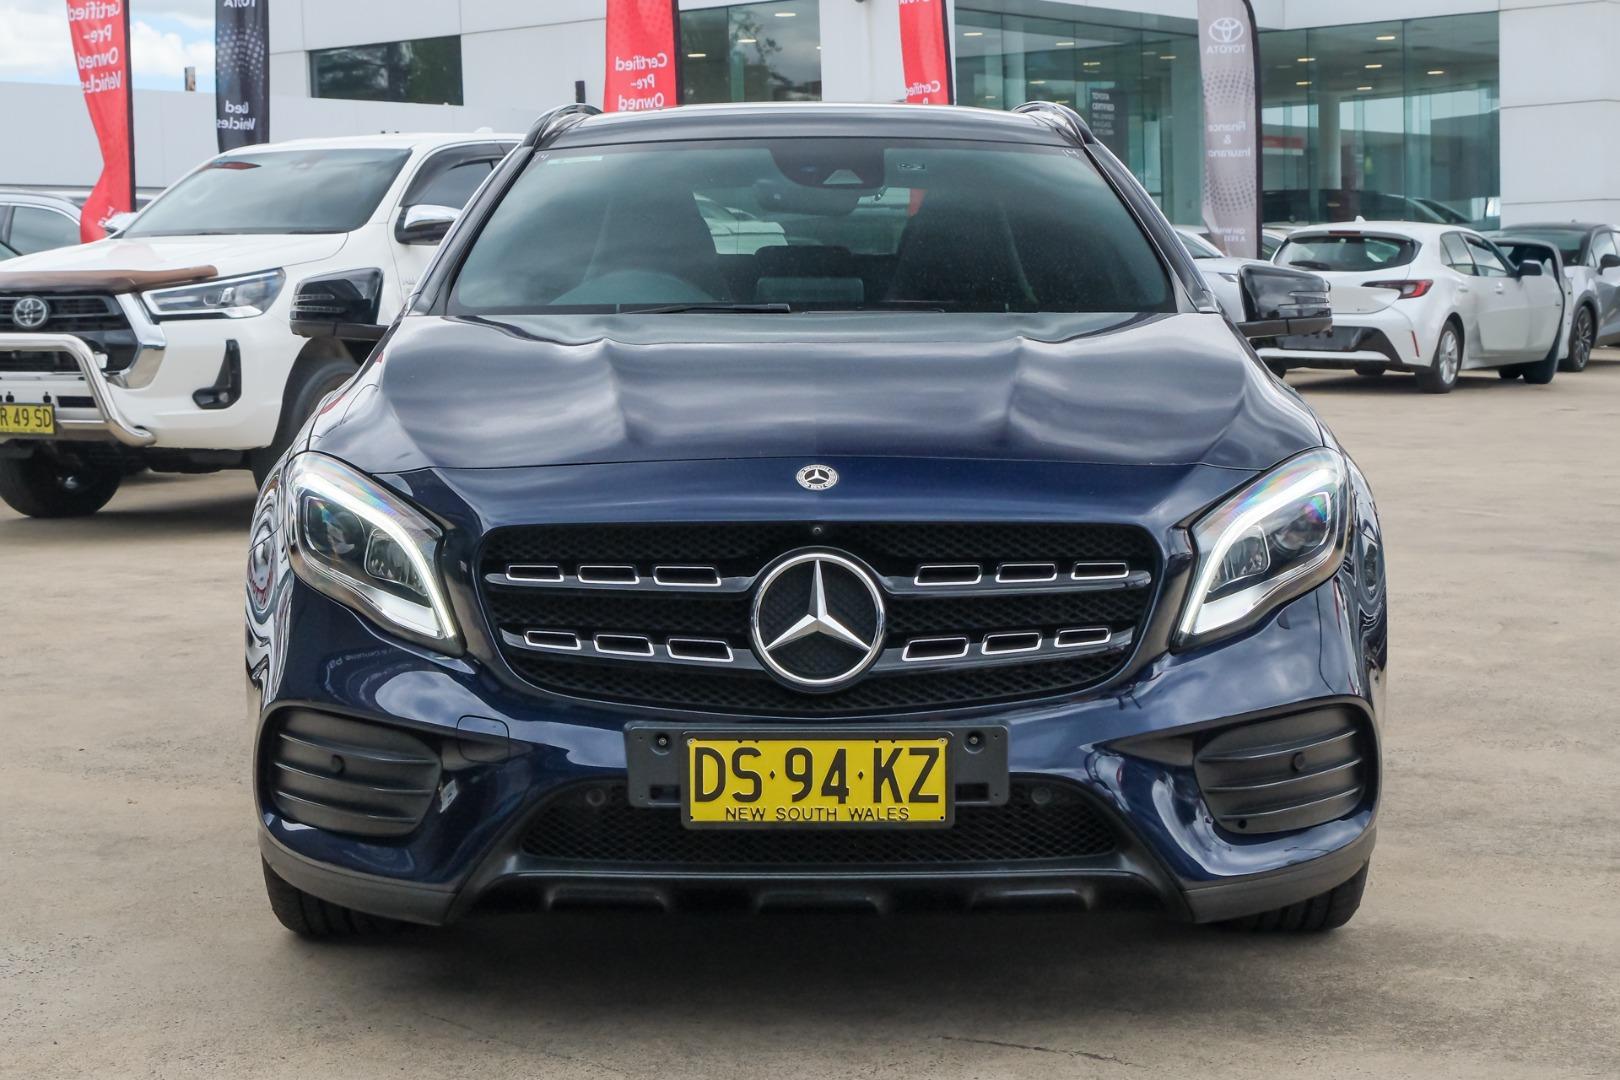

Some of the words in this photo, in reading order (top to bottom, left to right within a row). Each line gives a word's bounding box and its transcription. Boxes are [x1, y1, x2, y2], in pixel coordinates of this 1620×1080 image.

[13, 407, 30, 427] 49
[34, 408, 52, 428] SD
[725, 807, 766, 821] NEW
[776, 806, 837, 821] SOUTH
[849, 807, 910, 821] WALES
